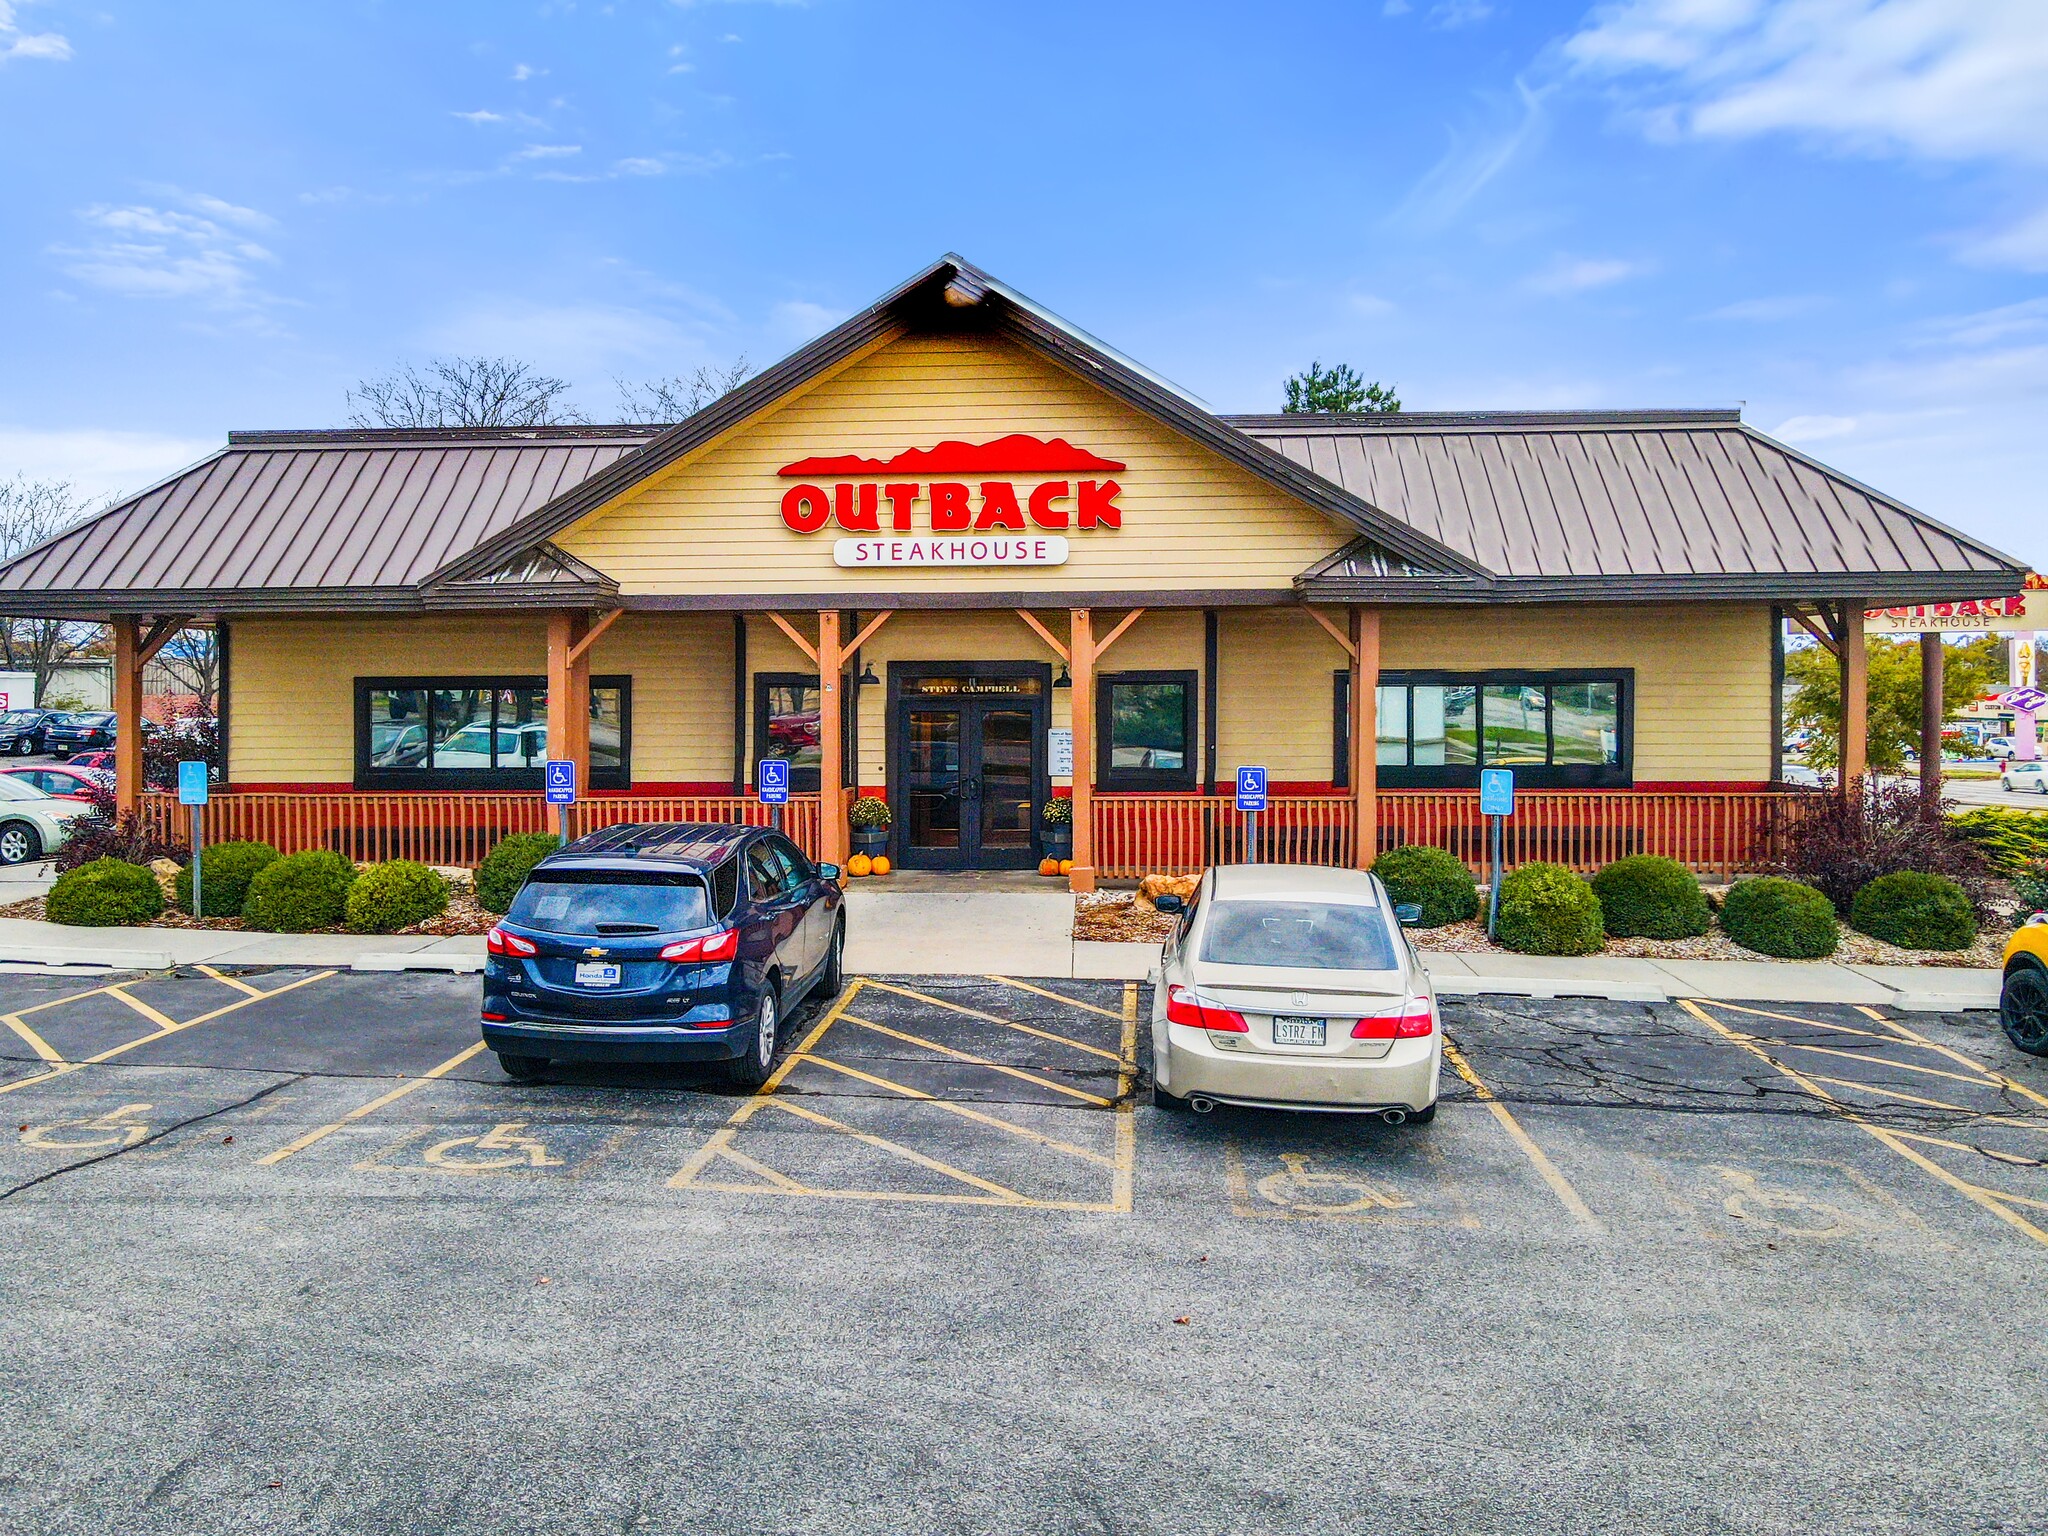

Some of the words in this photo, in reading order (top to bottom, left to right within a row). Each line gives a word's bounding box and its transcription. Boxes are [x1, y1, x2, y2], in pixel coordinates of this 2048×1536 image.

[780, 479, 1122, 534] OUTBACK
[855, 541, 1047, 562] STEAKHOUSE
[1891, 617, 1990, 629] STEAKHOUSE
[921, 685, 958, 693] STEVE
[962, 685, 1021, 693] CAMPBELL
